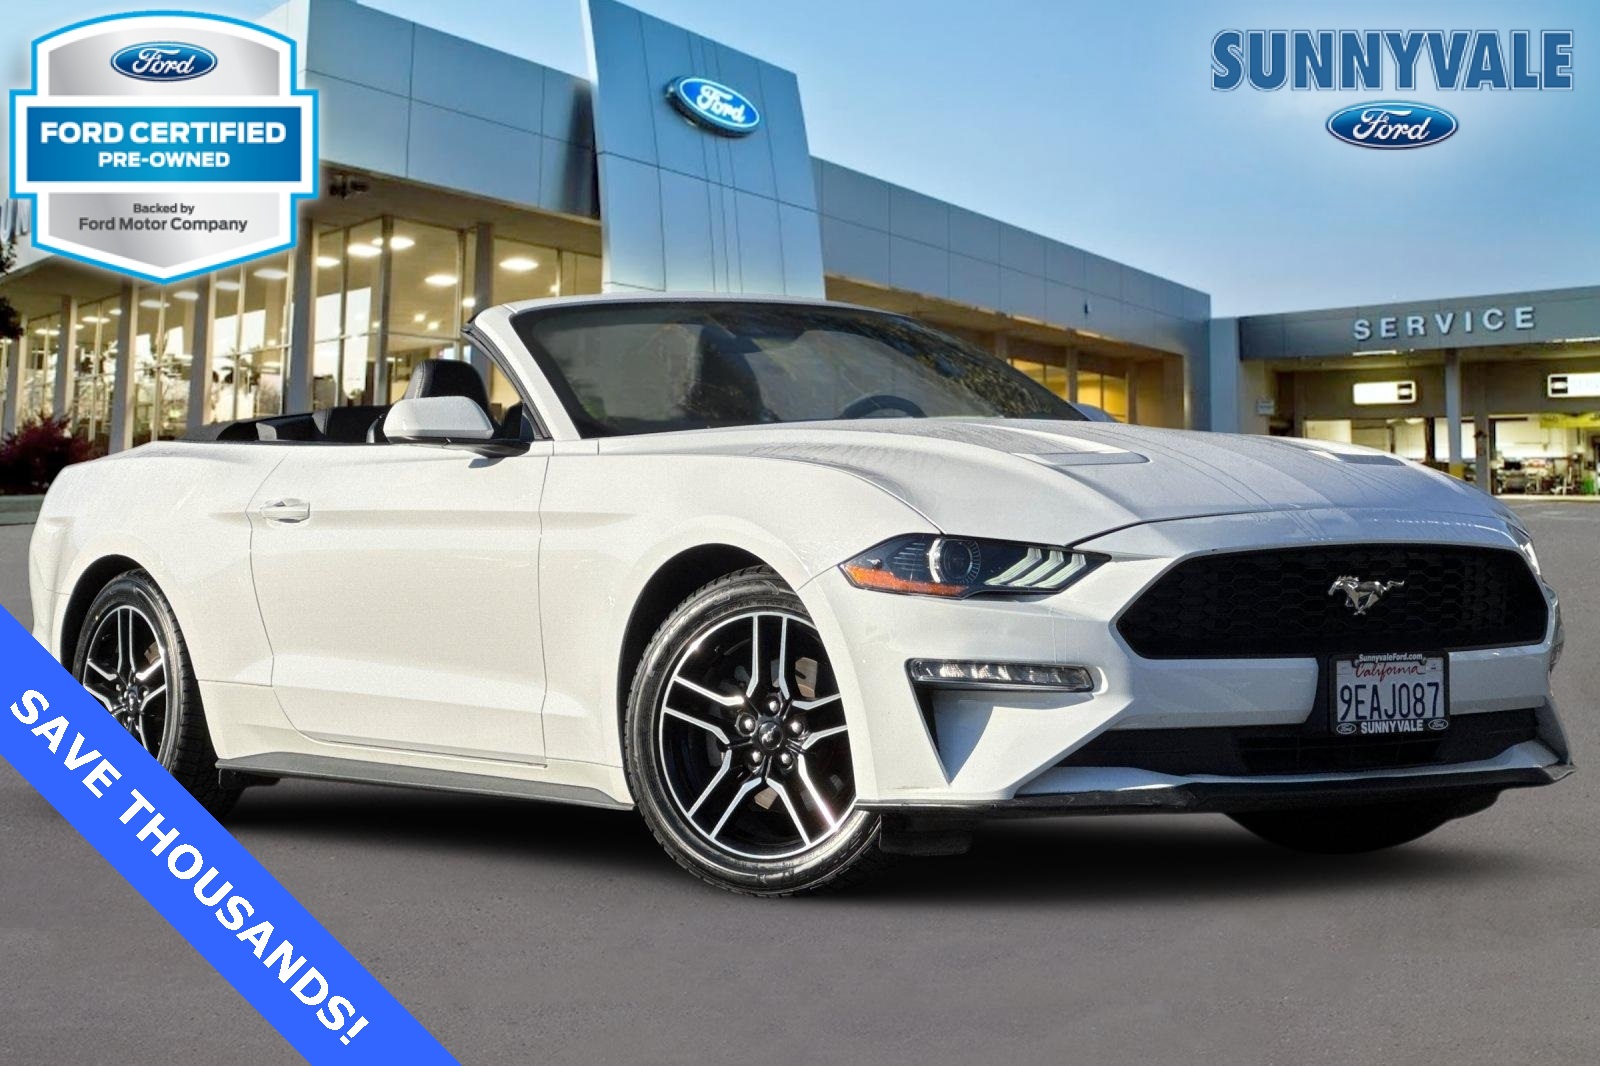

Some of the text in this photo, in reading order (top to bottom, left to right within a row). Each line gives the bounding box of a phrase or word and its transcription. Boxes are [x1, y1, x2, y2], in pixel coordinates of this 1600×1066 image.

[696, 84, 746, 123] Ford
[1353, 306, 1536, 341] SERVICE
[1359, 653, 1422, 661] SunnyvaleFord.com
[1355, 661, 1425, 682] California
[1340, 682, 1440, 721] 9EAJ087
[1361, 720, 1424, 734] SUNNYVALE
